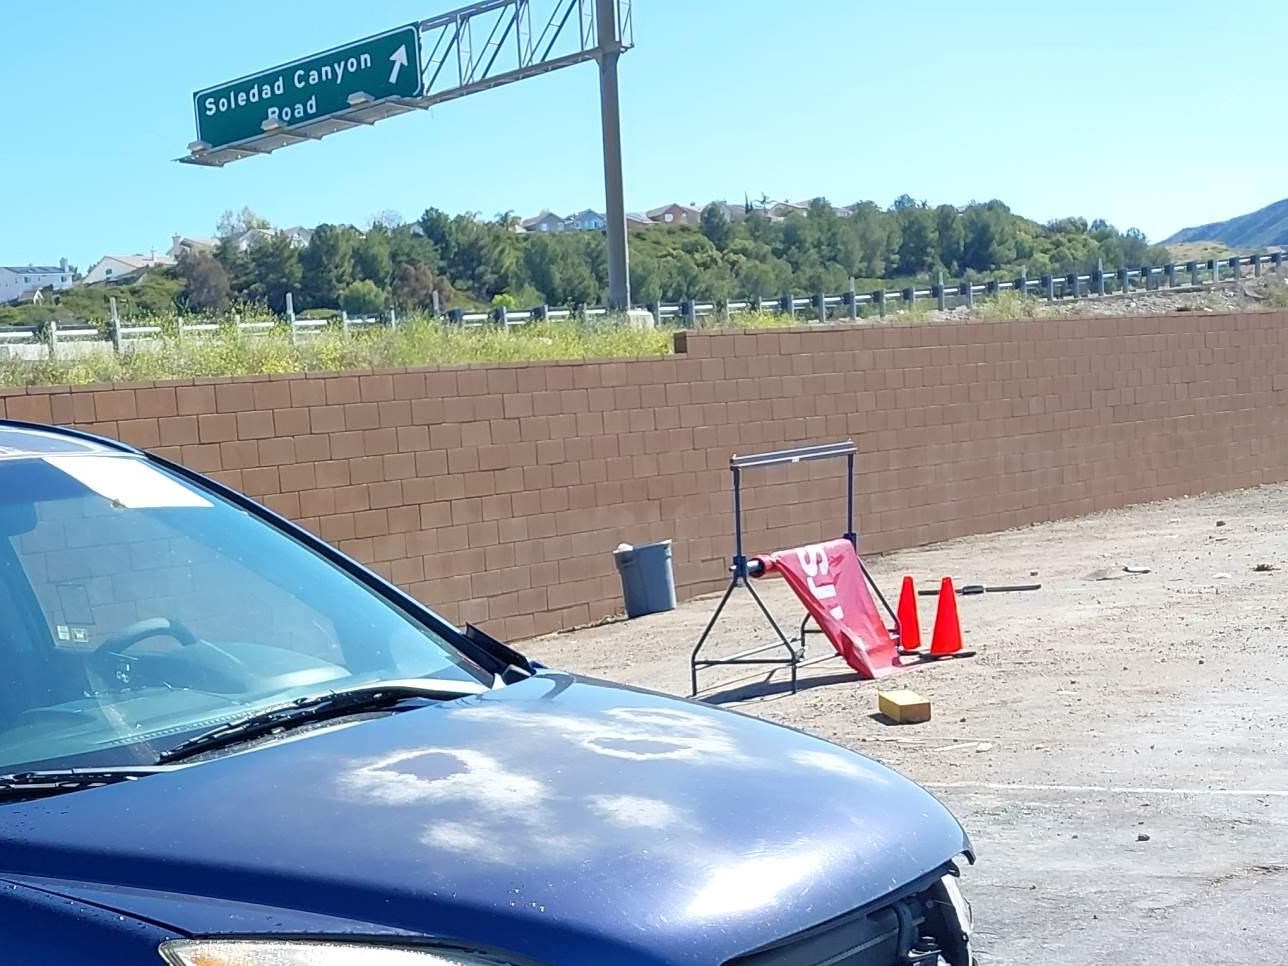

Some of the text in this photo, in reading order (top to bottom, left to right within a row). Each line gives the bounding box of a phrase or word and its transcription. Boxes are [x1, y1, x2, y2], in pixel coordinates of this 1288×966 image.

[205, 53, 372, 116] Soledad Canyon
[267, 96, 317, 121] Road
